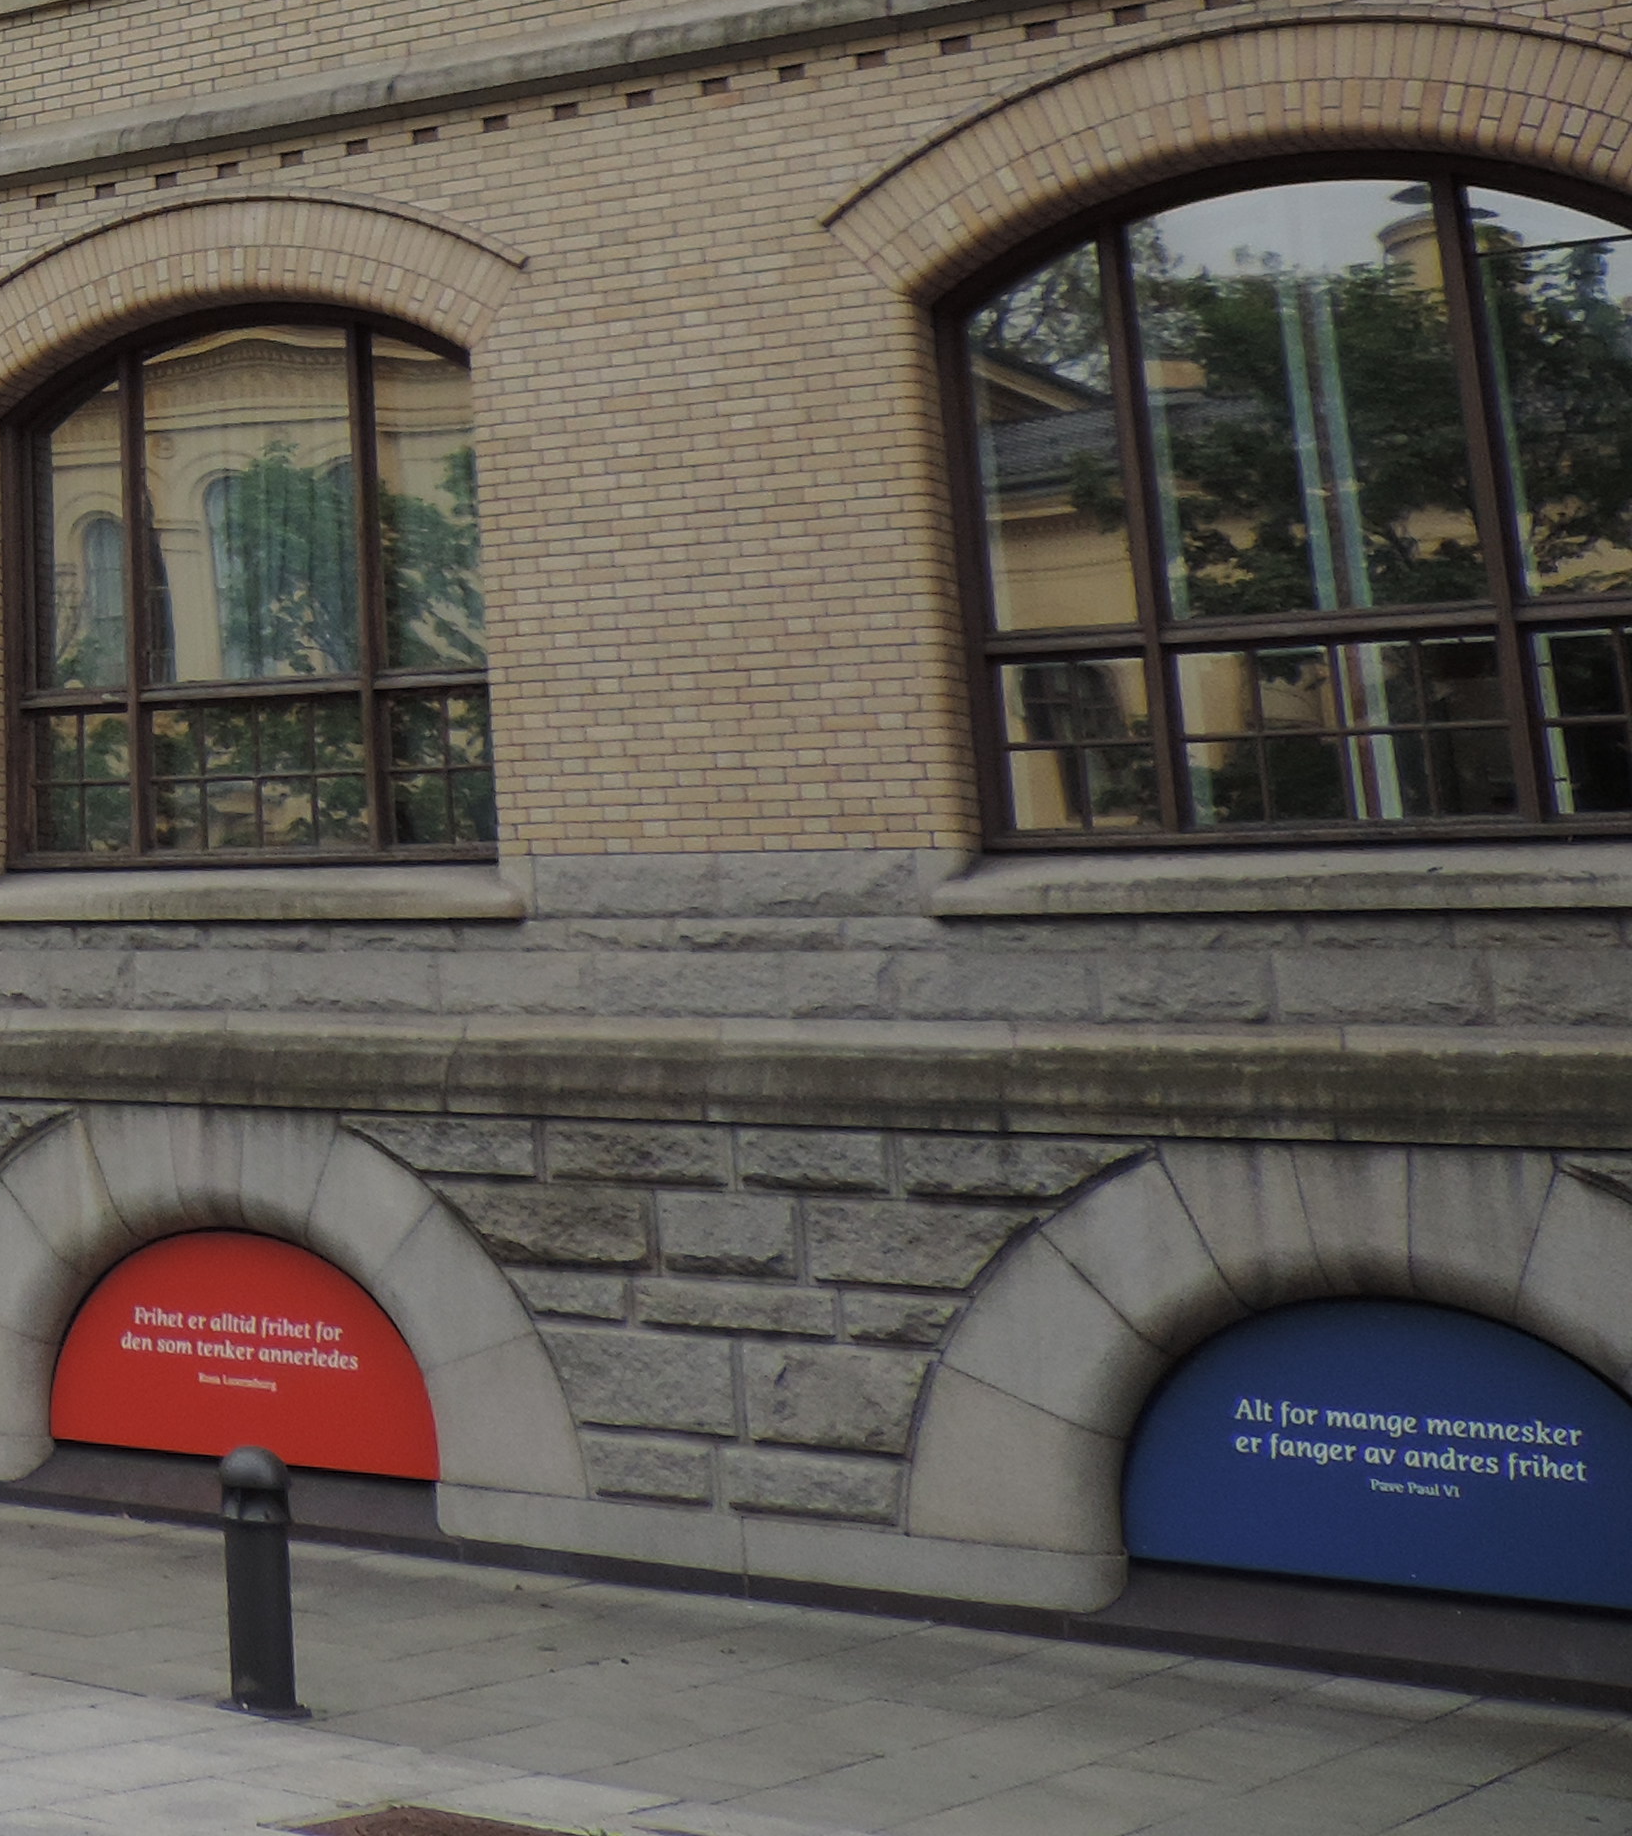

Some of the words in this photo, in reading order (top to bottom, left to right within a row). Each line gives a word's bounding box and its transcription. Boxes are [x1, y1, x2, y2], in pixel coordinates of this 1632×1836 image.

[134, 1306, 183, 1328] Frihet
[188, 1314, 207, 1330] er
[210, 1314, 256, 1334] alltid
[261, 1316, 312, 1339] frihet
[316, 1321, 343, 1343] for
[120, 1331, 153, 1351] den
[157, 1339, 193, 1355] som
[197, 1339, 255, 1361] tenker
[259, 1348, 359, 1370] annerledes
[1235, 1398, 1273, 1422] Alt
[1280, 1401, 1318, 1428] for
[1325, 1407, 1417, 1438] mange
[1426, 1416, 1582, 1447] mennesker
[1236, 1435, 1262, 1453] er
[1270, 1433, 1357, 1465] fanger
[1364, 1447, 1396, 1465] av
[1404, 1447, 1499, 1475] andres
[1507, 1452, 1587, 1482] frihet
[1370, 1478, 1404, 1494] Pave
[1407, 1481, 1440, 1498] Paul
[1444, 1484, 1461, 1499] VI
